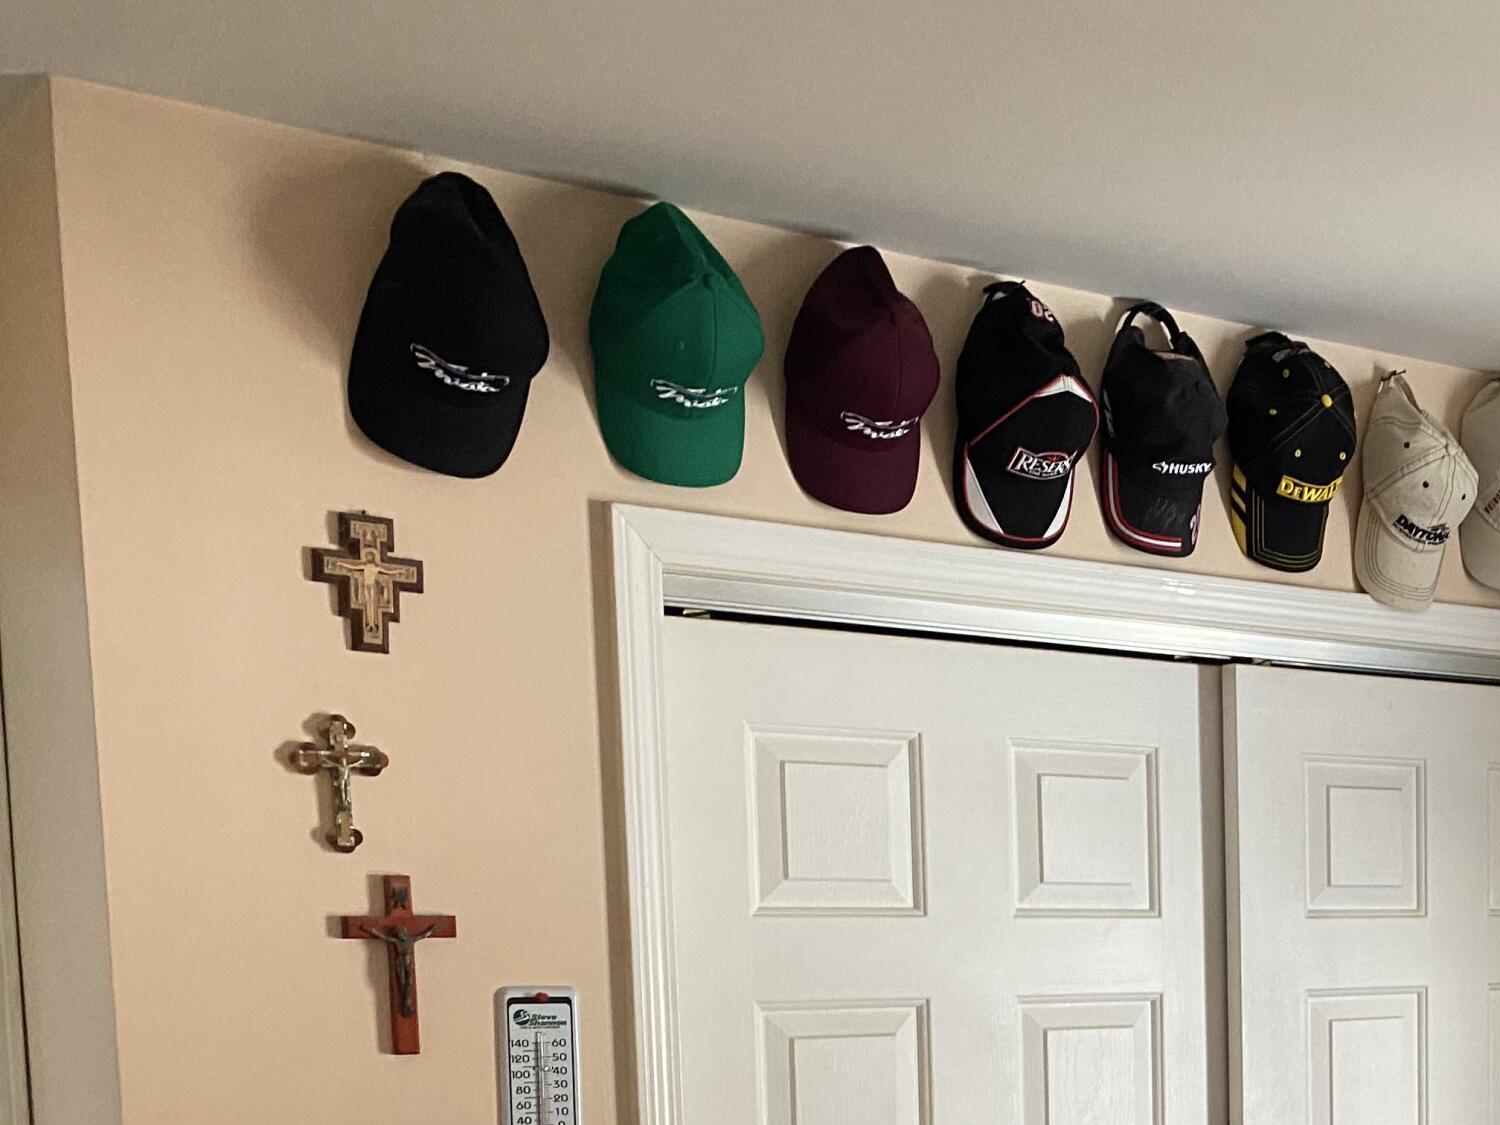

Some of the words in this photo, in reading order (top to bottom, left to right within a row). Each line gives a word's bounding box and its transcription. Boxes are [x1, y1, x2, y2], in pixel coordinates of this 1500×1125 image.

[1169, 462, 1212, 474] HUSKY
[511, 1039, 529, 1047] 140
[552, 1039, 566, 1047] 60
[511, 1055, 530, 1063] 120
[552, 1053, 567, 1061] 50
[512, 1070, 530, 1079] 100
[553, 1066, 568, 1075] 40
[553, 1080, 568, 1088] 30
[515, 1086, 531, 1094] 80
[553, 1094, 568, 1102] 20
[516, 1101, 531, 1110] 60
[556, 1107, 569, 1116] 10
[516, 1116, 532, 1125] 40
